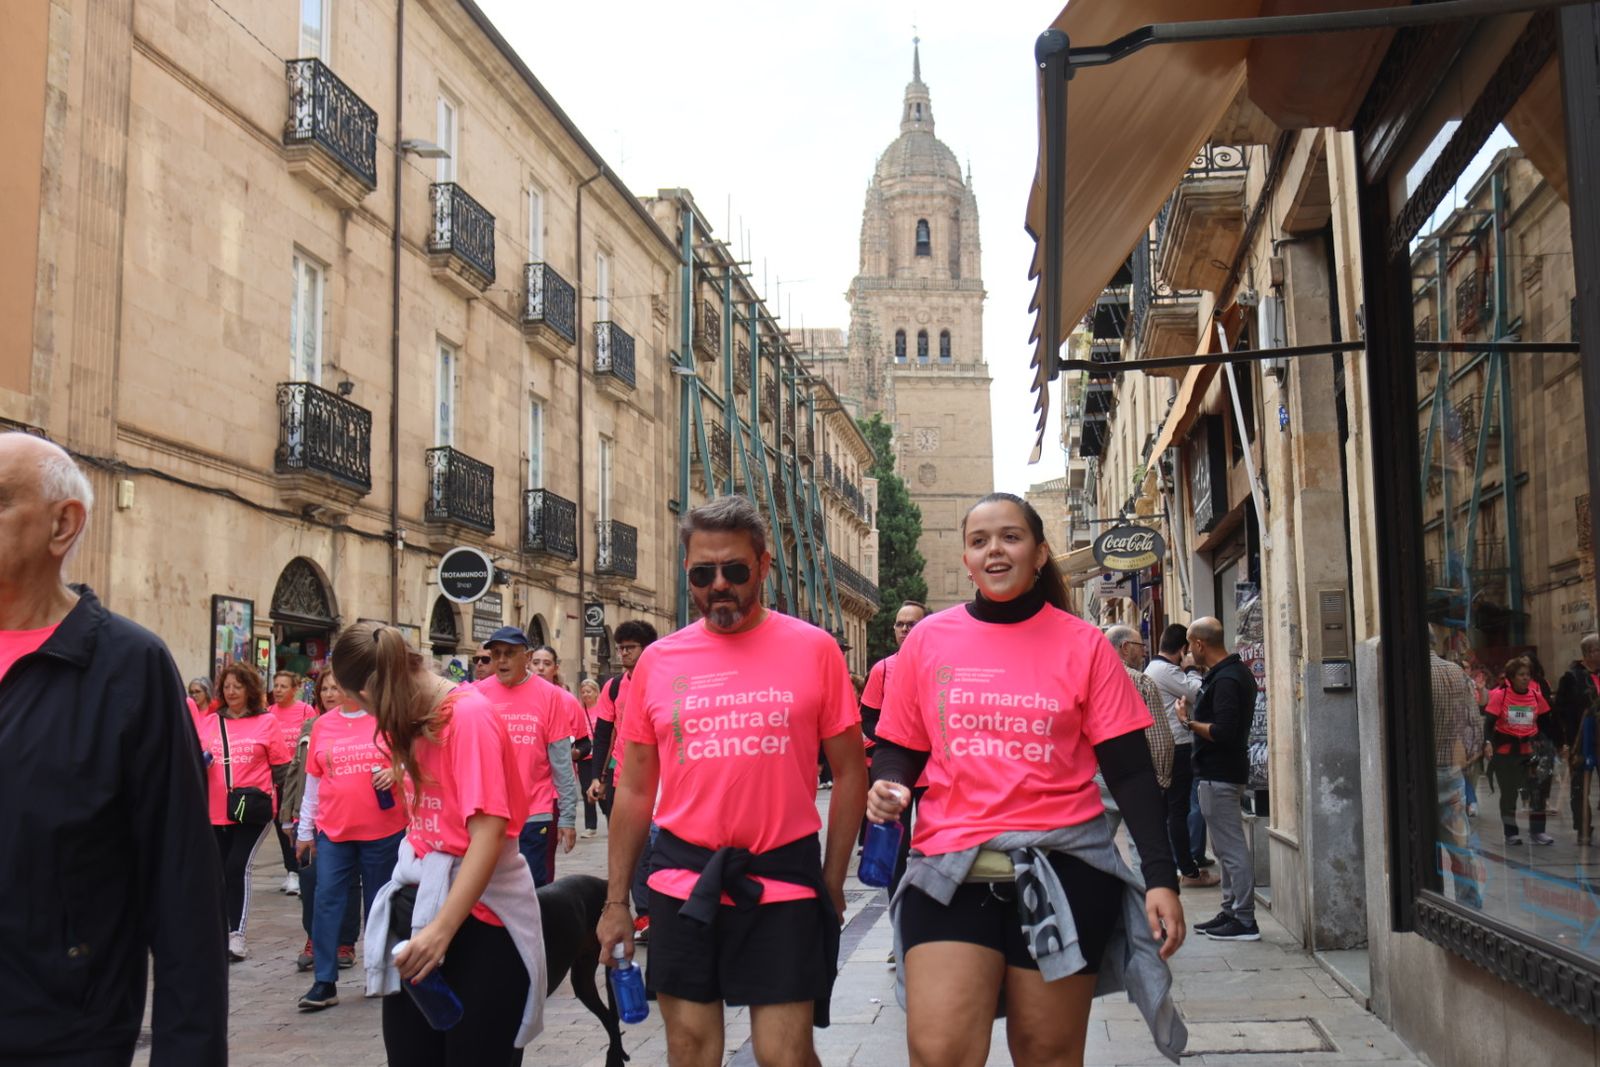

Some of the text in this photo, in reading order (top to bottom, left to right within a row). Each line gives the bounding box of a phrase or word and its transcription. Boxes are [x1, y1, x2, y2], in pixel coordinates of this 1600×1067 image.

[1102, 532, 1155, 554] Coca-Cola
[685, 686, 794, 711] En marcha
[949, 688, 1060, 713] En marcha
[508, 722, 537, 733] tra el
[684, 707, 790, 734] contra el
[948, 711, 1054, 737] contra el
[332, 745, 345, 754] En
[511, 734, 537, 745] cer
[687, 733, 791, 761] cáncer
[951, 731, 1055, 764] cáncer
[332, 752, 373, 764] contra
[425, 814, 441, 833] el
